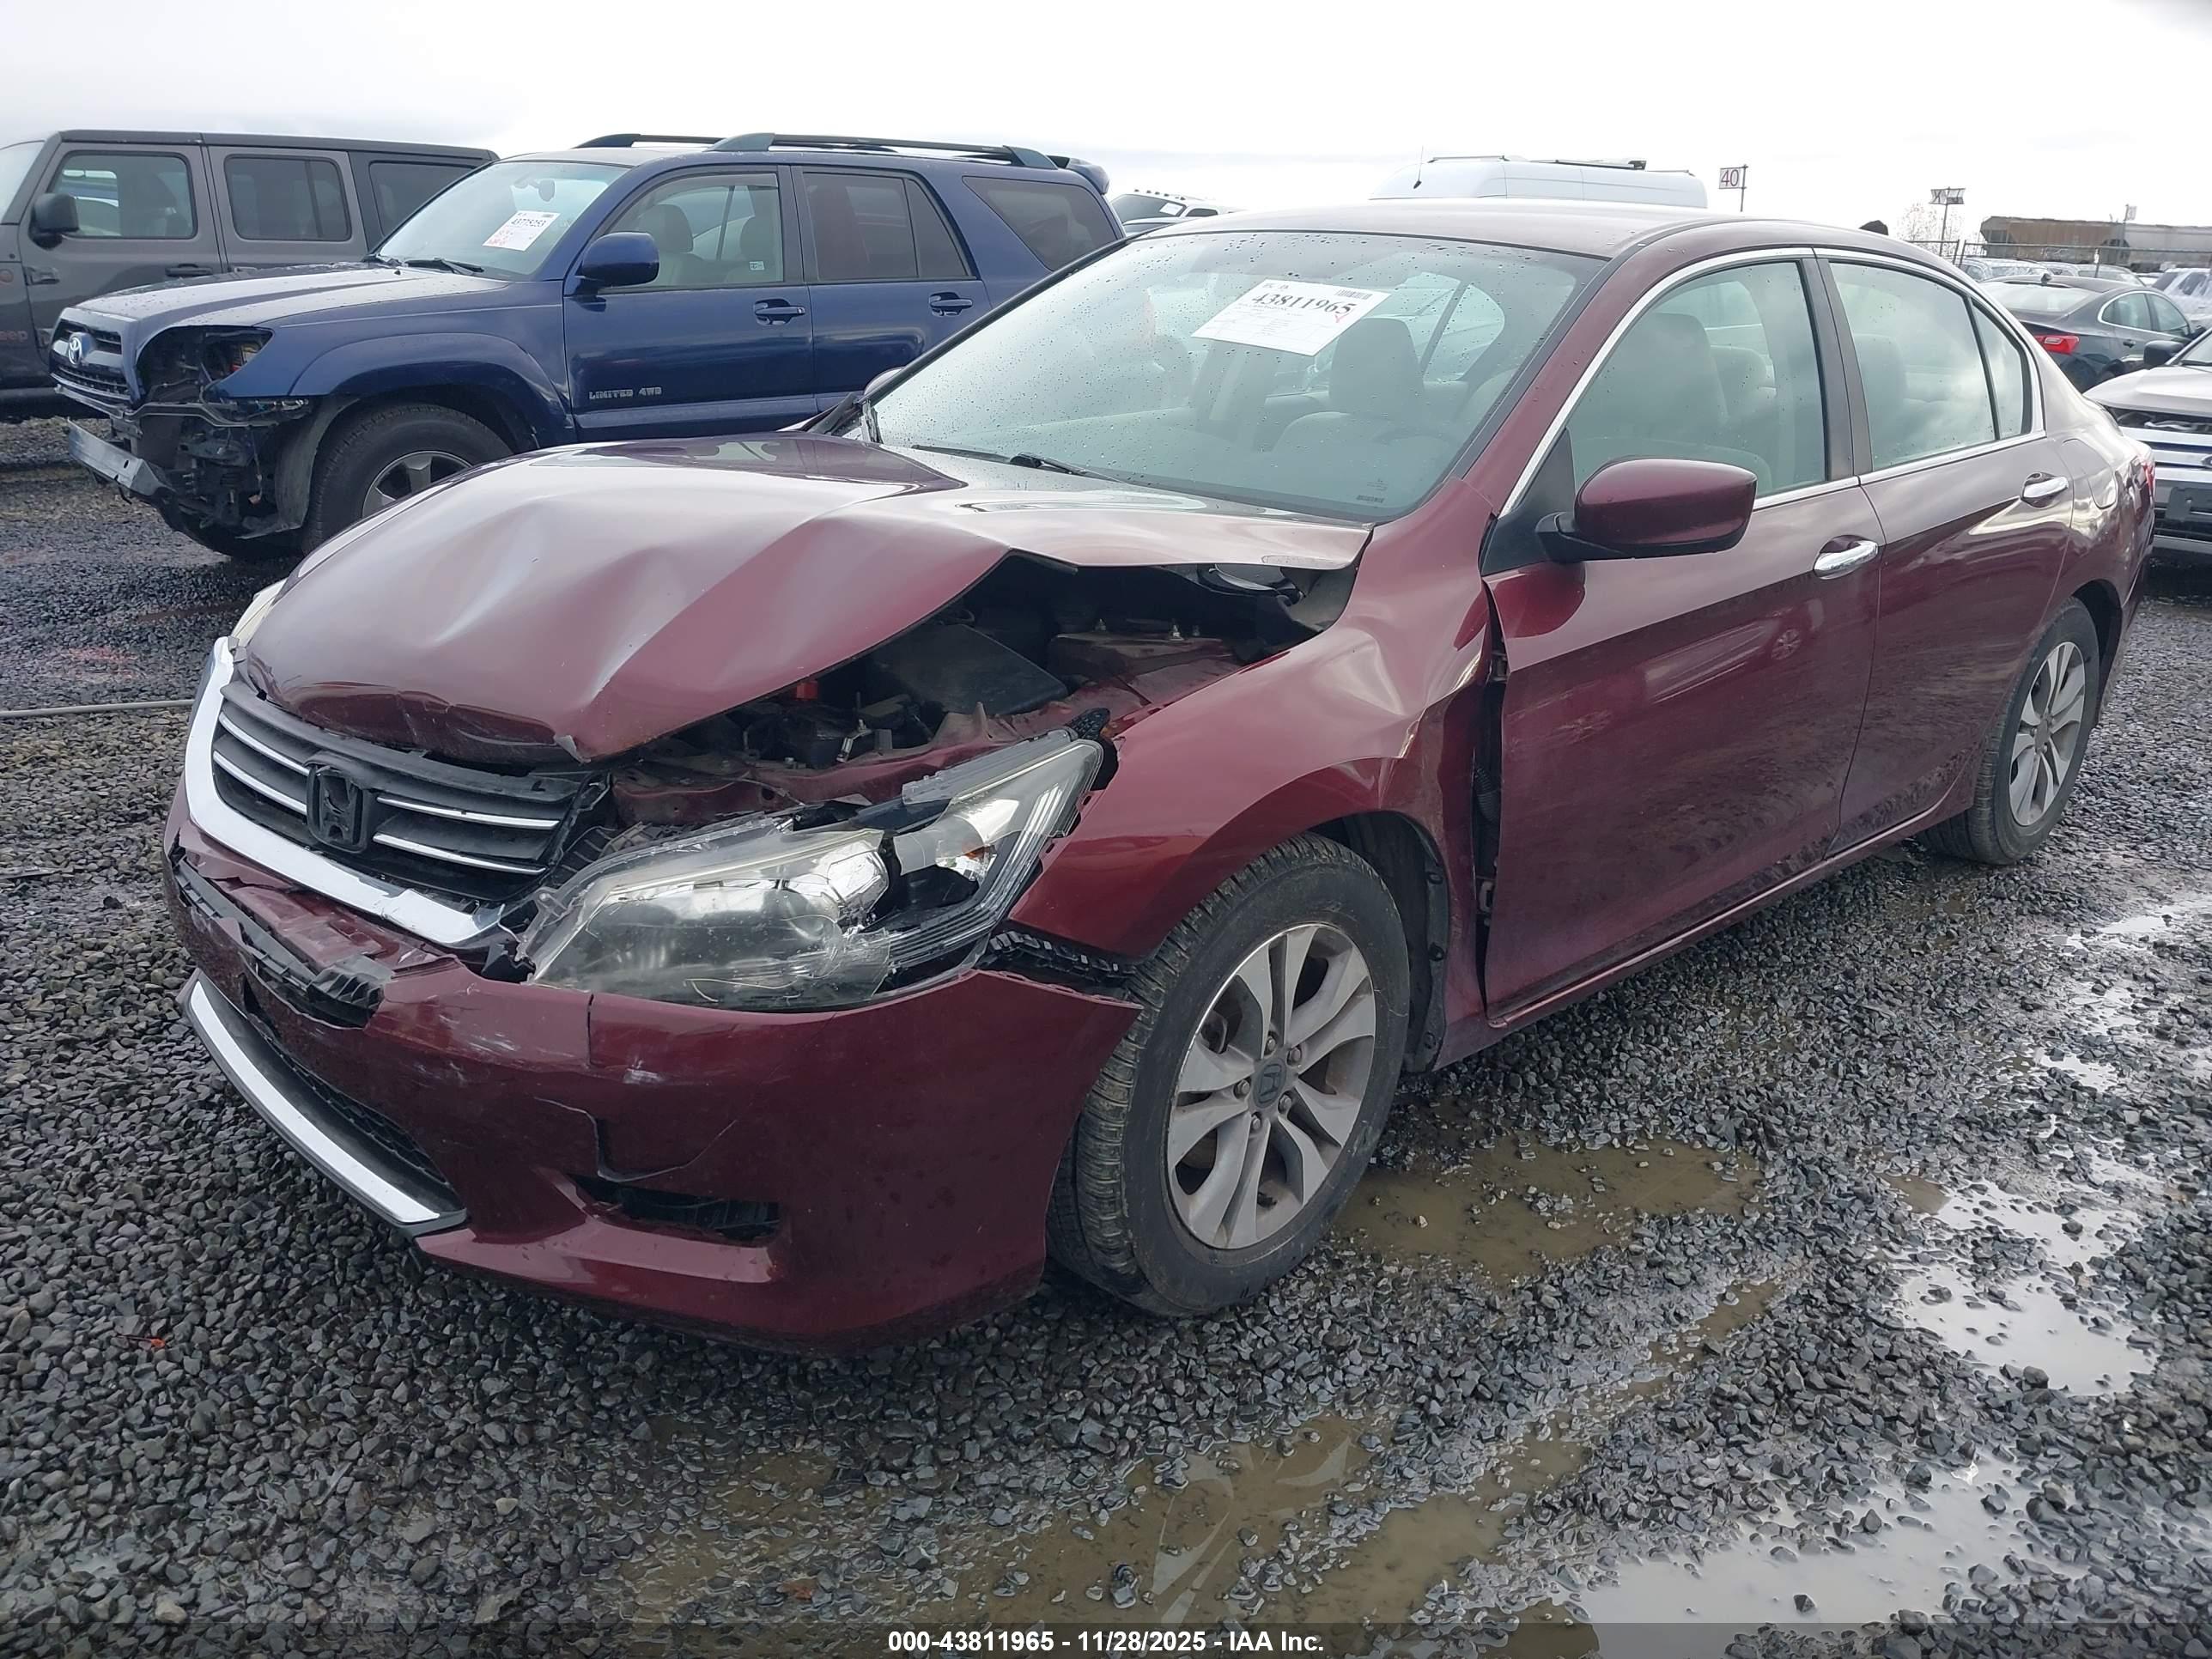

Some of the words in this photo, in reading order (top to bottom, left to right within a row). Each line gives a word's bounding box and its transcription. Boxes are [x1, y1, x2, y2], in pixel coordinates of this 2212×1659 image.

[1721, 169, 1739, 186] 40
[1252, 293, 1357, 314] 43811965
[0, 331, 27, 343] eep
[589, 389, 634, 399] LIMITED
[639, 386, 661, 396] 4WD
